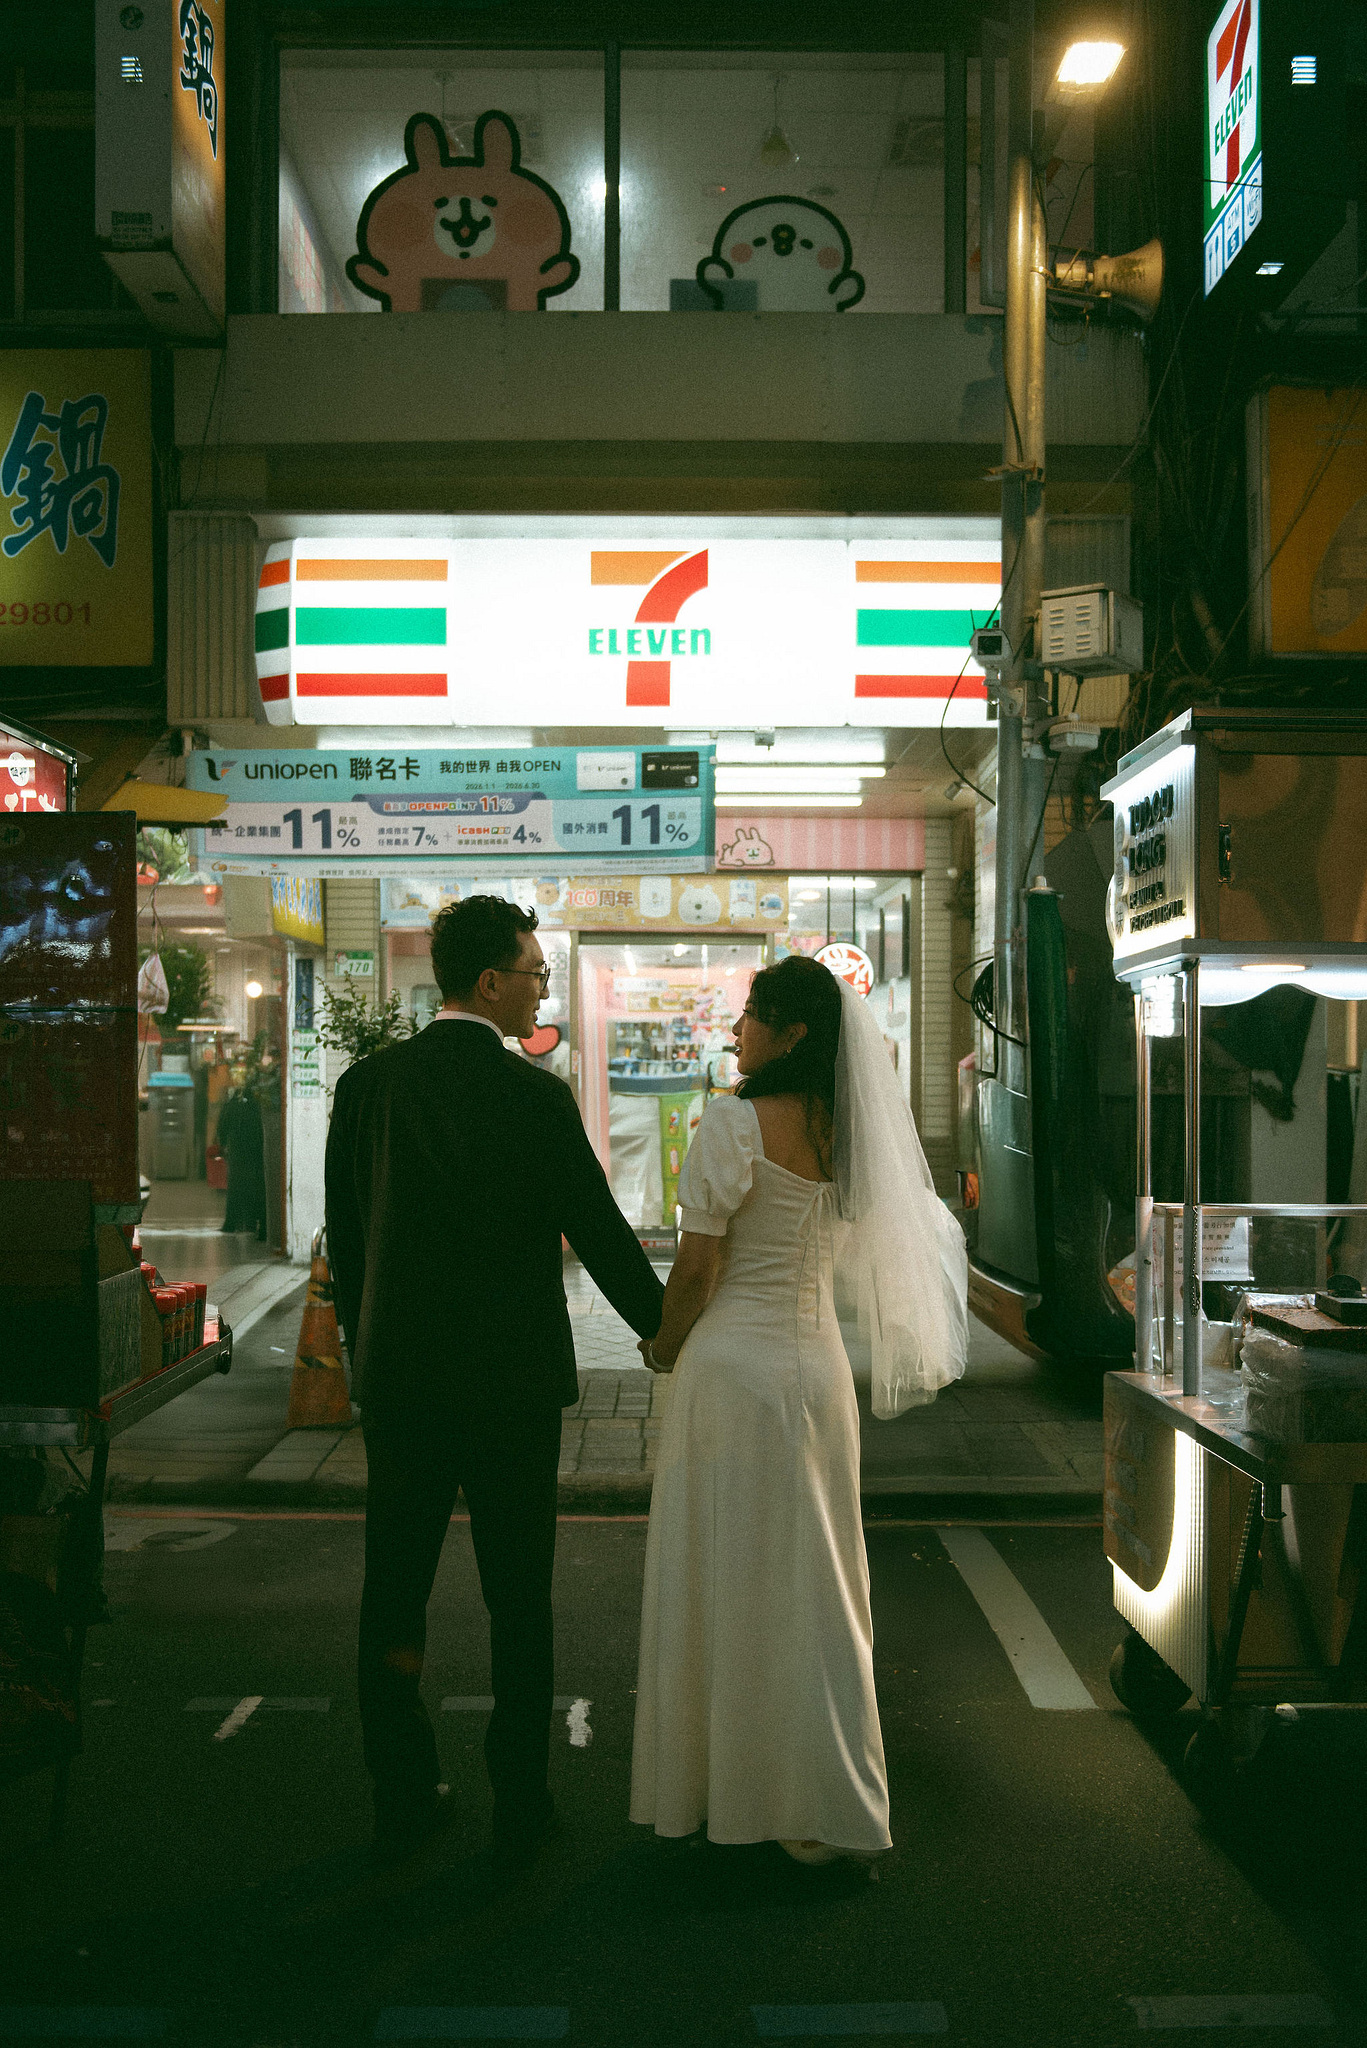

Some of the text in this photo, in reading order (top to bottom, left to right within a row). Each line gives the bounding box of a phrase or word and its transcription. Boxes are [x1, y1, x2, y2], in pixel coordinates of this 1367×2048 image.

[1, 390, 121, 568] 鍋
[350, 757, 420, 781] 聯名卡
[440, 760, 491, 774] 我的世界
[562, 822, 608, 835] 國外消費
[348, 962, 370, 973] 170
